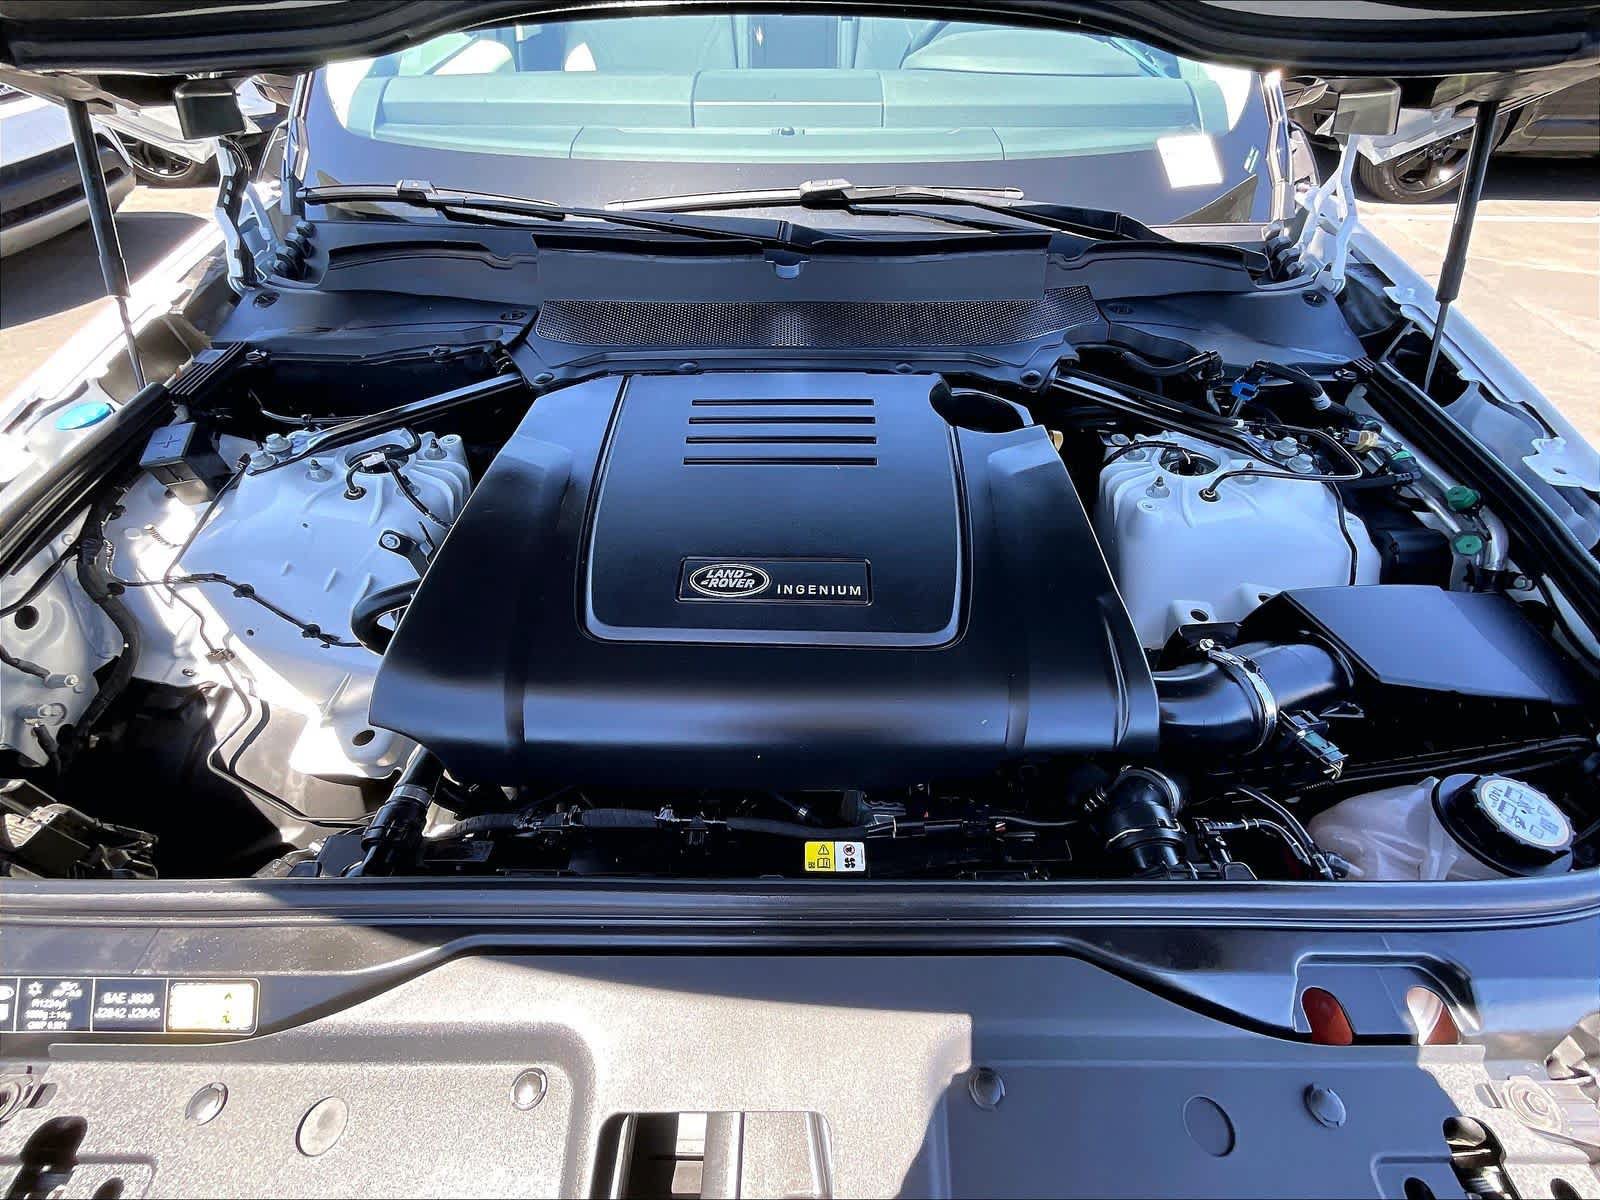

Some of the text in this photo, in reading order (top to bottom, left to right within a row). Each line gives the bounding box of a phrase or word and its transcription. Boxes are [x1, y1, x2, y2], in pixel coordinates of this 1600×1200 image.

[706, 569, 744, 578] LAND
[708, 578, 755, 588] ROVER
[777, 584, 861, 596] INGENIUM
[103, 991, 127, 1004] SAE
